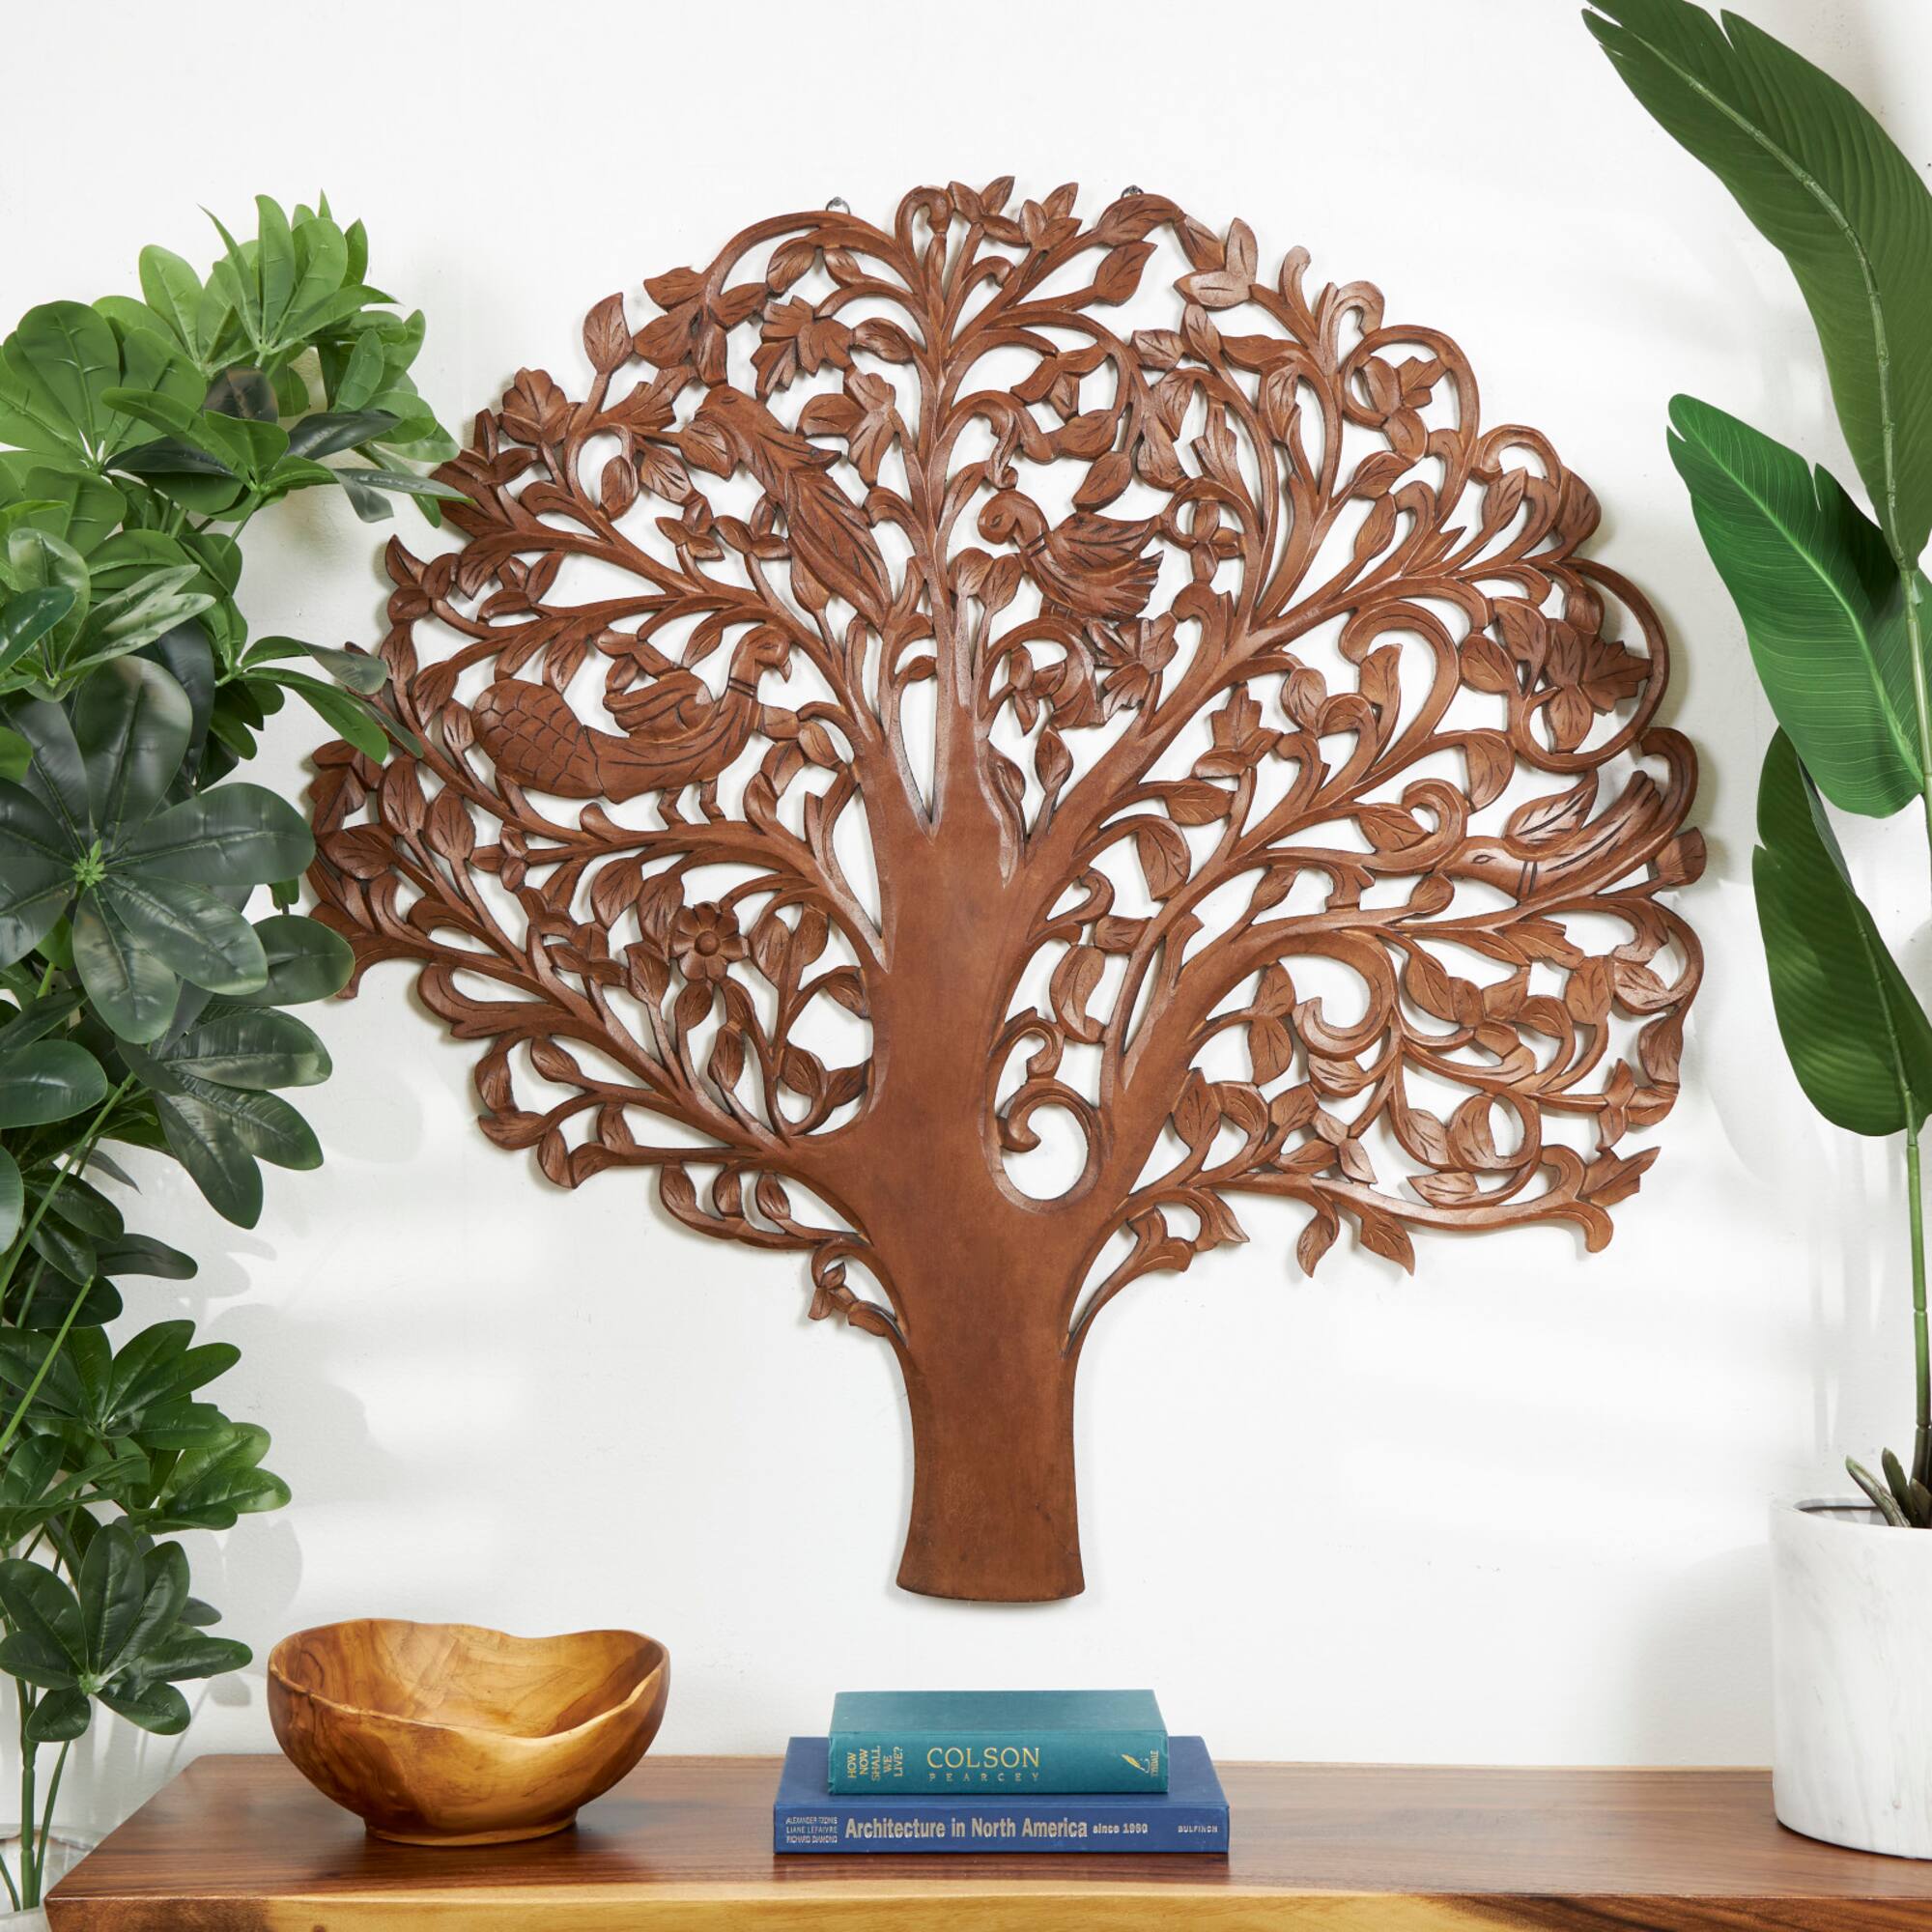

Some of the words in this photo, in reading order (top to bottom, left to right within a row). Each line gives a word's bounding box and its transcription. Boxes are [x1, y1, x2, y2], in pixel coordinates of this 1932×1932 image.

[847, 1752, 857, 1778] HOW
[859, 1748, 868, 1776] NOW
[871, 1746, 881, 1781] SHALL
[883, 1755, 893, 1774] WE
[894, 1747, 903, 1777] LIVE?
[927, 1747, 1040, 1768] COLSON
[929, 1773, 1040, 1781] PEARCEY
[844, 1817, 946, 1838] Architecture
[951, 1817, 965, 1838] in
[971, 1817, 1015, 1838] North
[1021, 1817, 1087, 1838] America
[1093, 1823, 1120, 1834] since
[1178, 1825, 1218, 1833] BULFINCH
